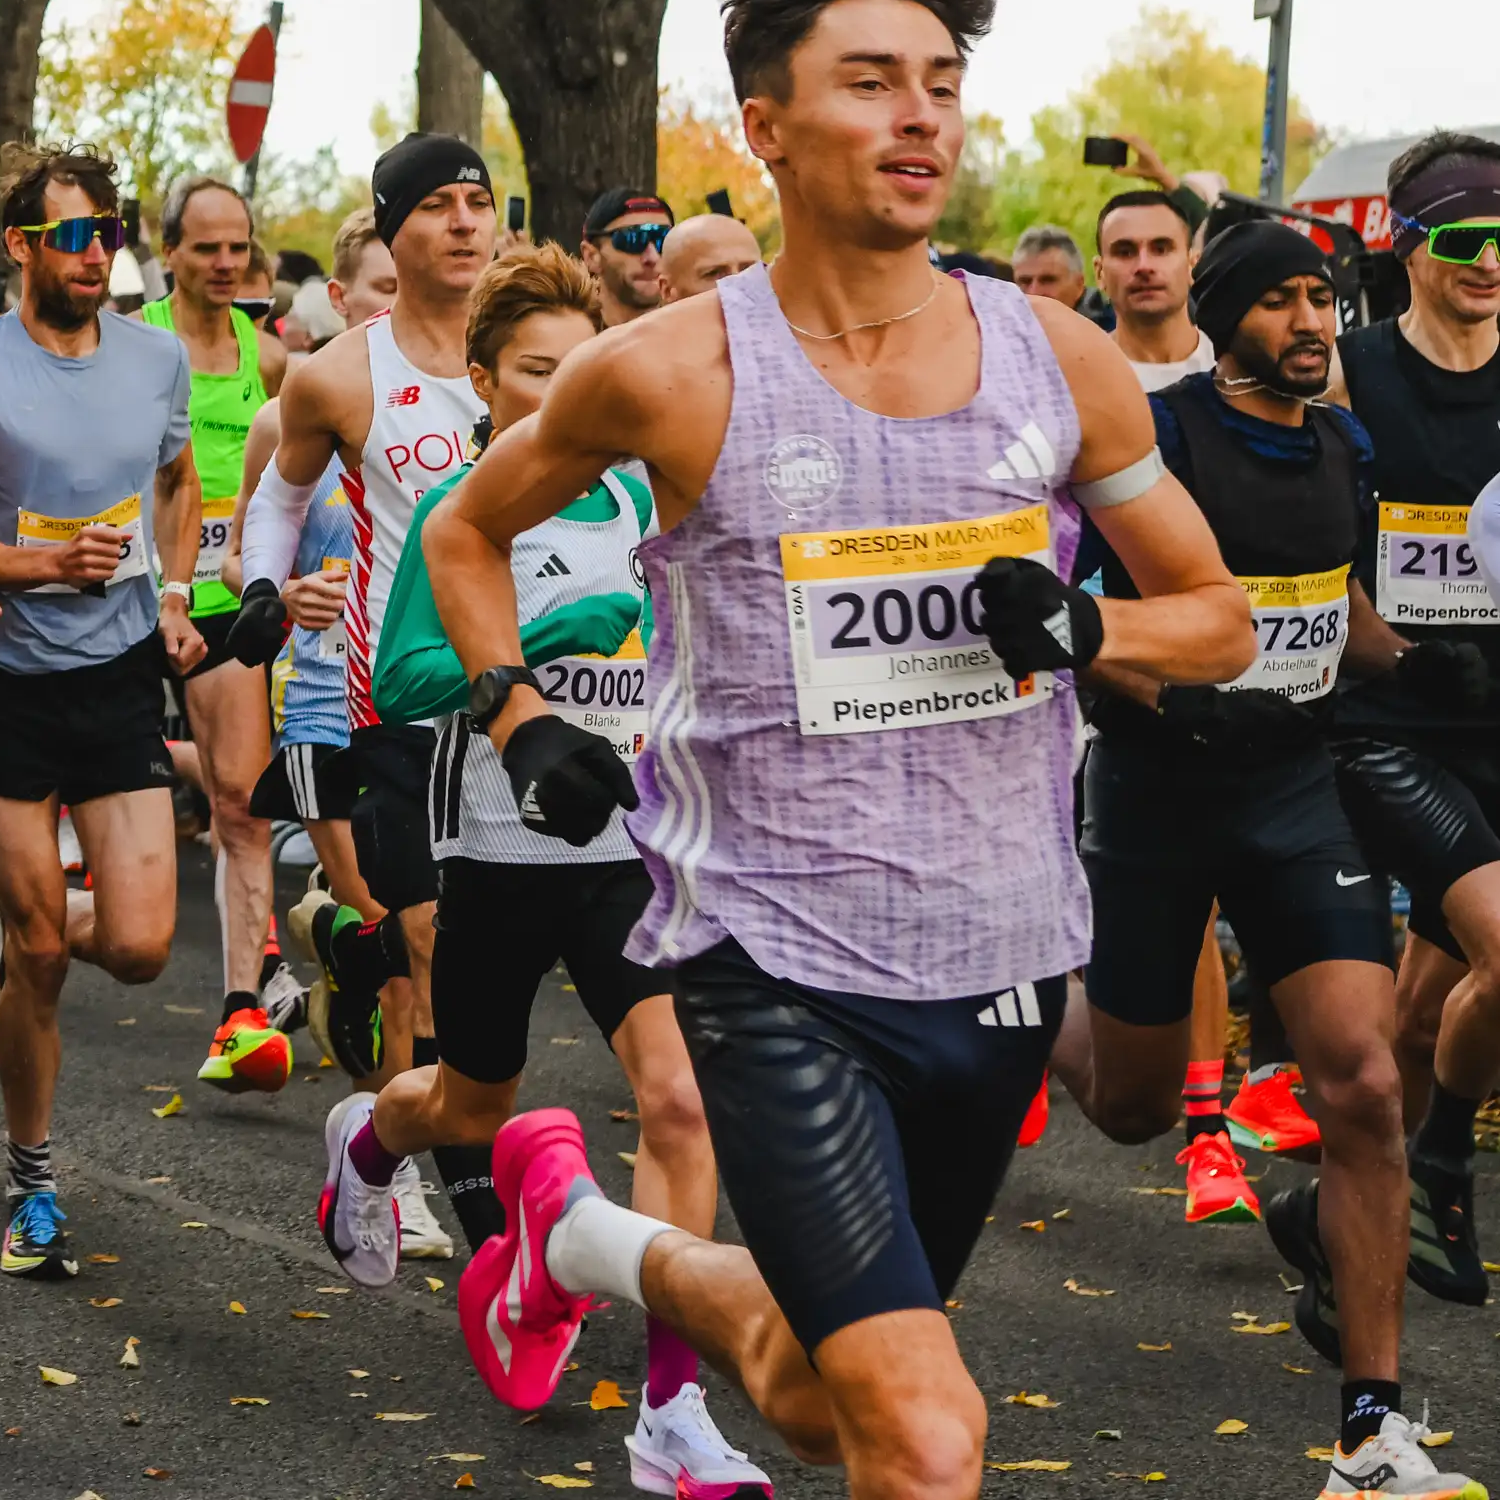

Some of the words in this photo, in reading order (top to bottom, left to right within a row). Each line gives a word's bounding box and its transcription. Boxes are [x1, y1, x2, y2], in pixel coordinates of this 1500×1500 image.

[1407, 509, 1468, 522] DRESDEN
[39, 519, 90, 532] DRESDEN
[830, 533, 928, 556] DRESDEN
[935, 517, 1038, 547] MARATHON
[1241, 582, 1300, 594] DRESDEN
[1440, 582, 1488, 594] Thoma
[1397, 603, 1500, 621] Piepenbroc
[1252, 609, 1340, 652] 7268
[888, 649, 990, 680] Johannes
[543, 664, 645, 707] 20002
[833, 682, 1009, 725] Piepenbrock
[584, 713, 621, 727] Blanka
